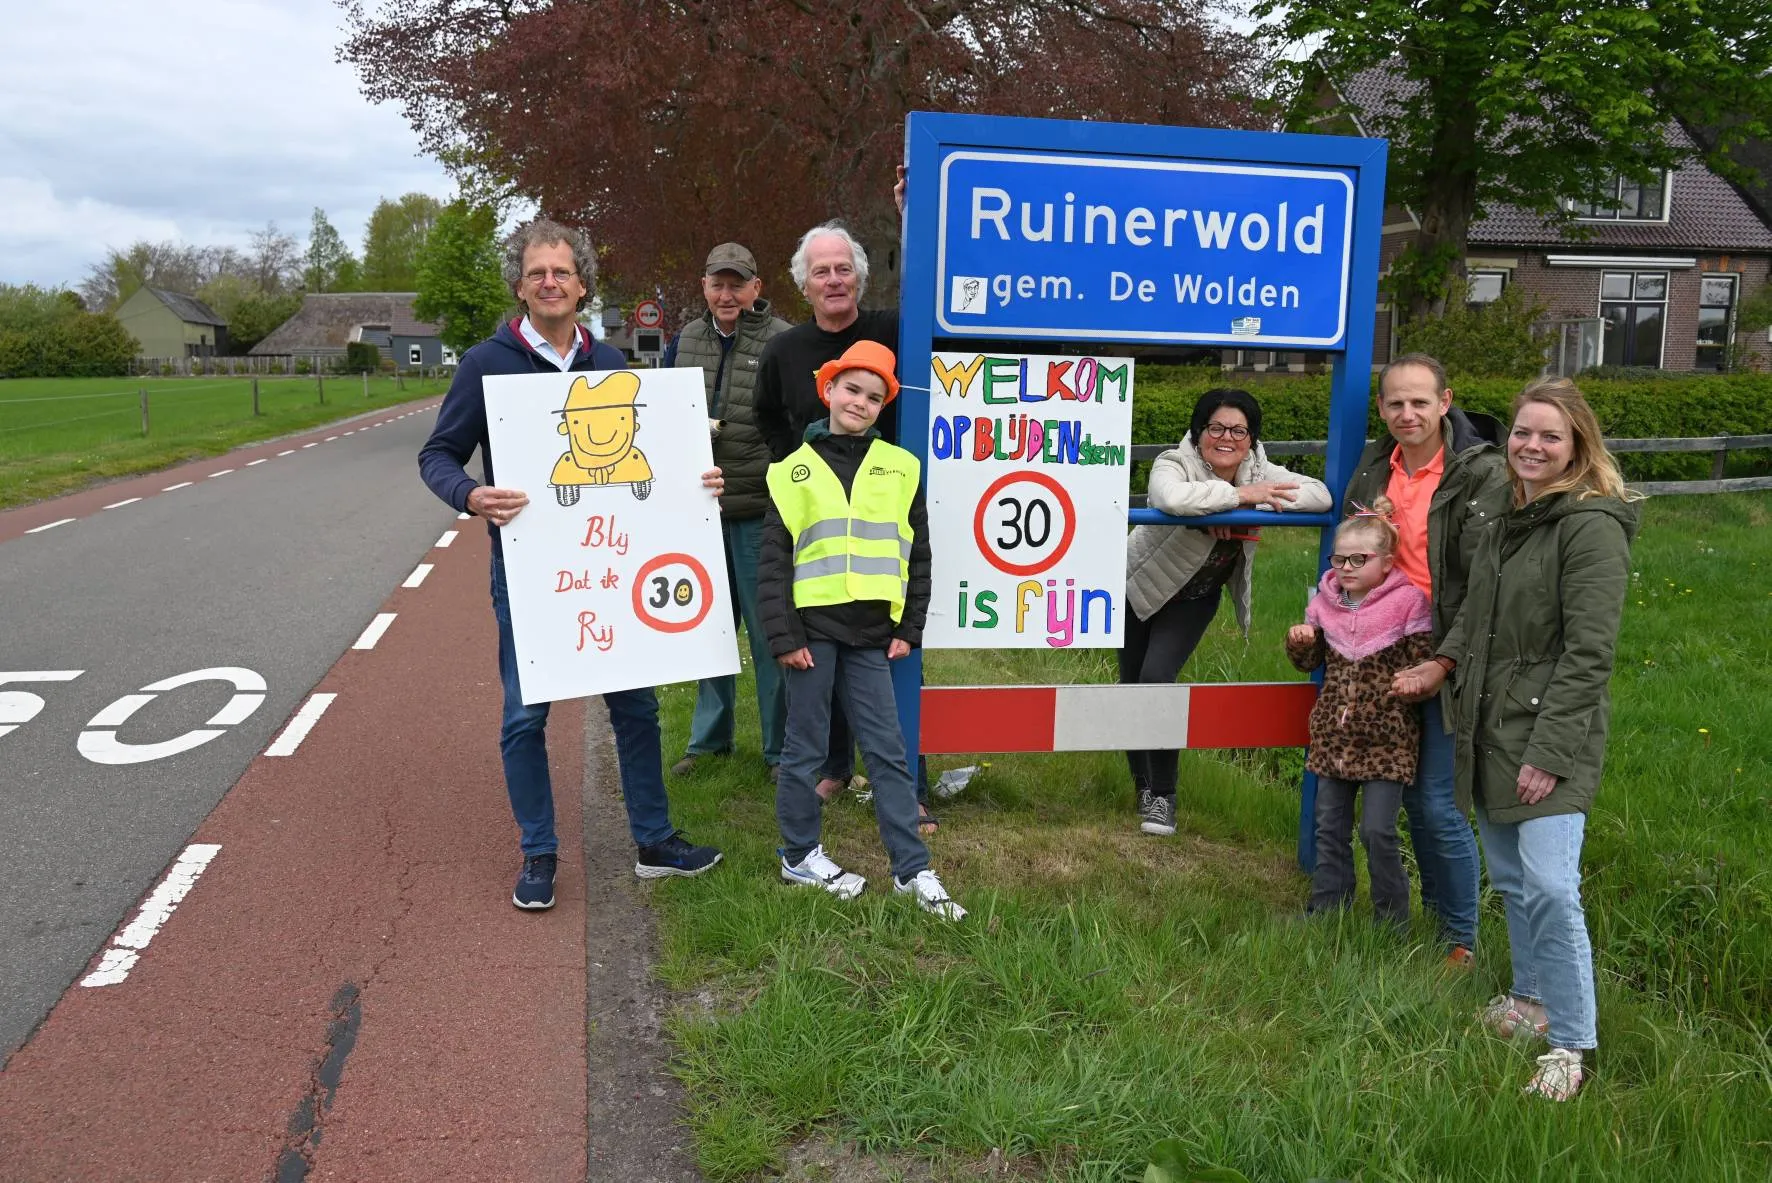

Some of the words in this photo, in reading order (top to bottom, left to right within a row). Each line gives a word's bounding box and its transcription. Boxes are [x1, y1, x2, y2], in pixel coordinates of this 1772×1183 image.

[971, 187, 1324, 254] Ruinerwold
[992, 273, 1084, 306] gem.
[1110, 271, 1156, 302] De
[1174, 273, 1299, 308] Wolden
[932, 354, 1128, 405] WELKOM
[794, 468, 806, 479] 30
[581, 515, 629, 556] Blij
[997, 497, 1051, 550] 30
[555, 570, 590, 594] Dat
[600, 567, 620, 590] ik
[649, 576, 693, 609] 30
[576, 611, 614, 652] Rij
[958, 580, 998, 629] is
[1016, 579, 1112, 647] fijn
